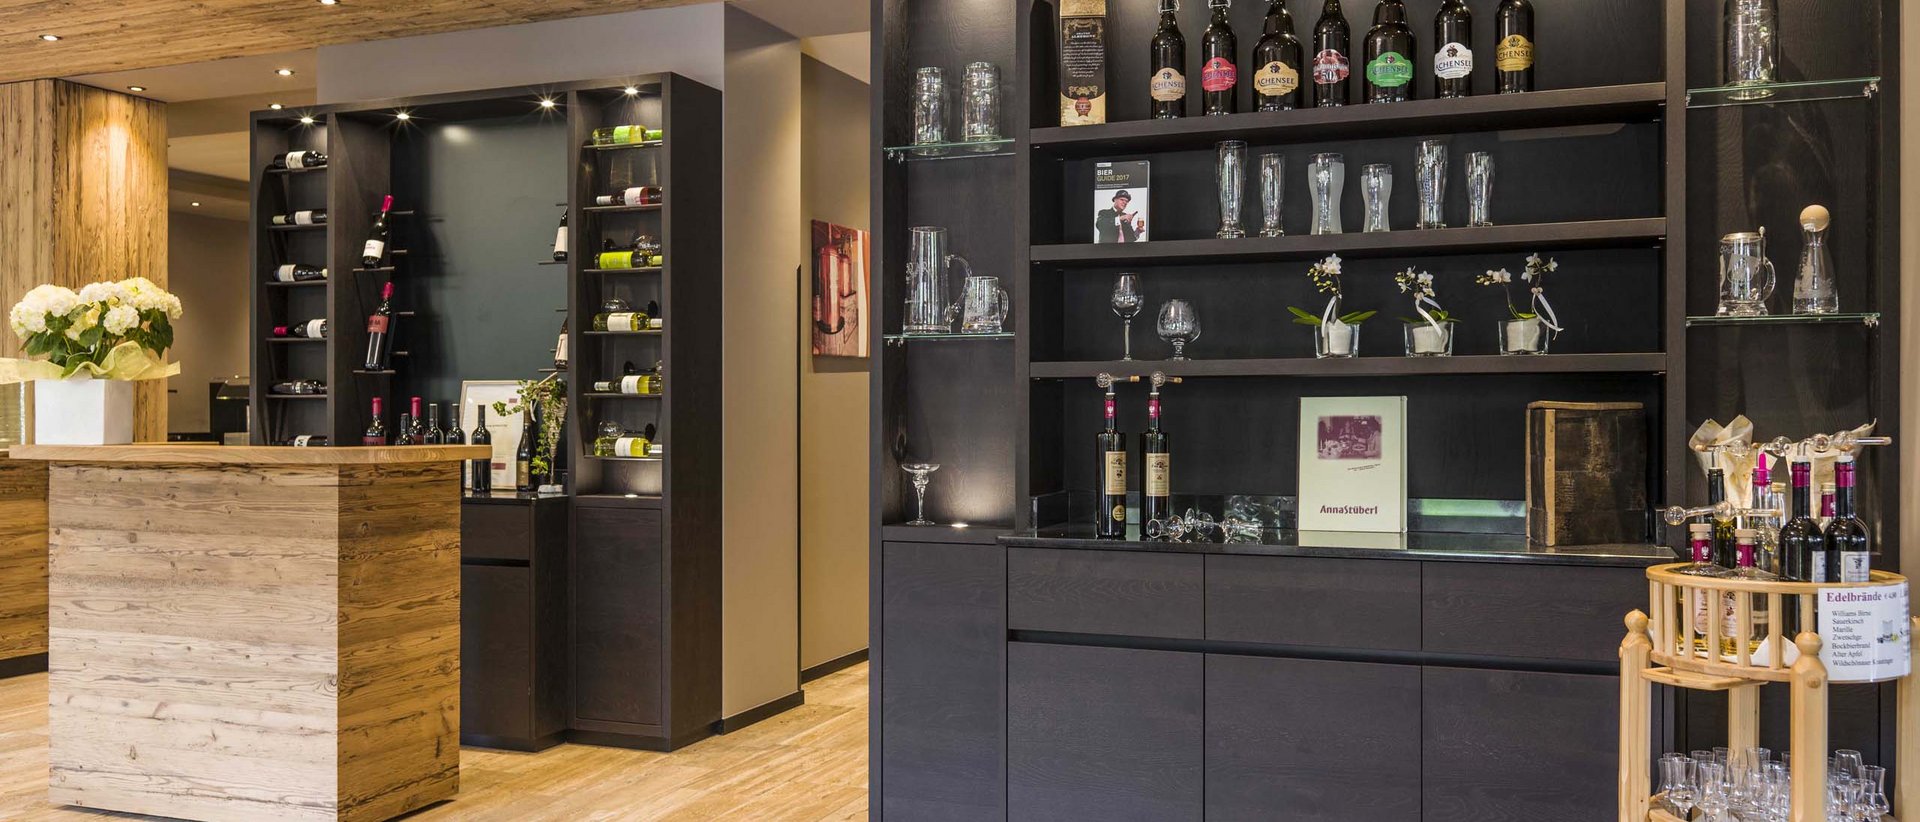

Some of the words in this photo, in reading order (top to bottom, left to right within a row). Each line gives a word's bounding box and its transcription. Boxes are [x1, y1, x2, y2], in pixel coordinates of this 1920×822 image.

[1256, 77, 1295, 86] ACHENSEE
[1320, 505, 1378, 514] AnnaStüberl
[1826, 592, 1882, 602] Edelbrände
